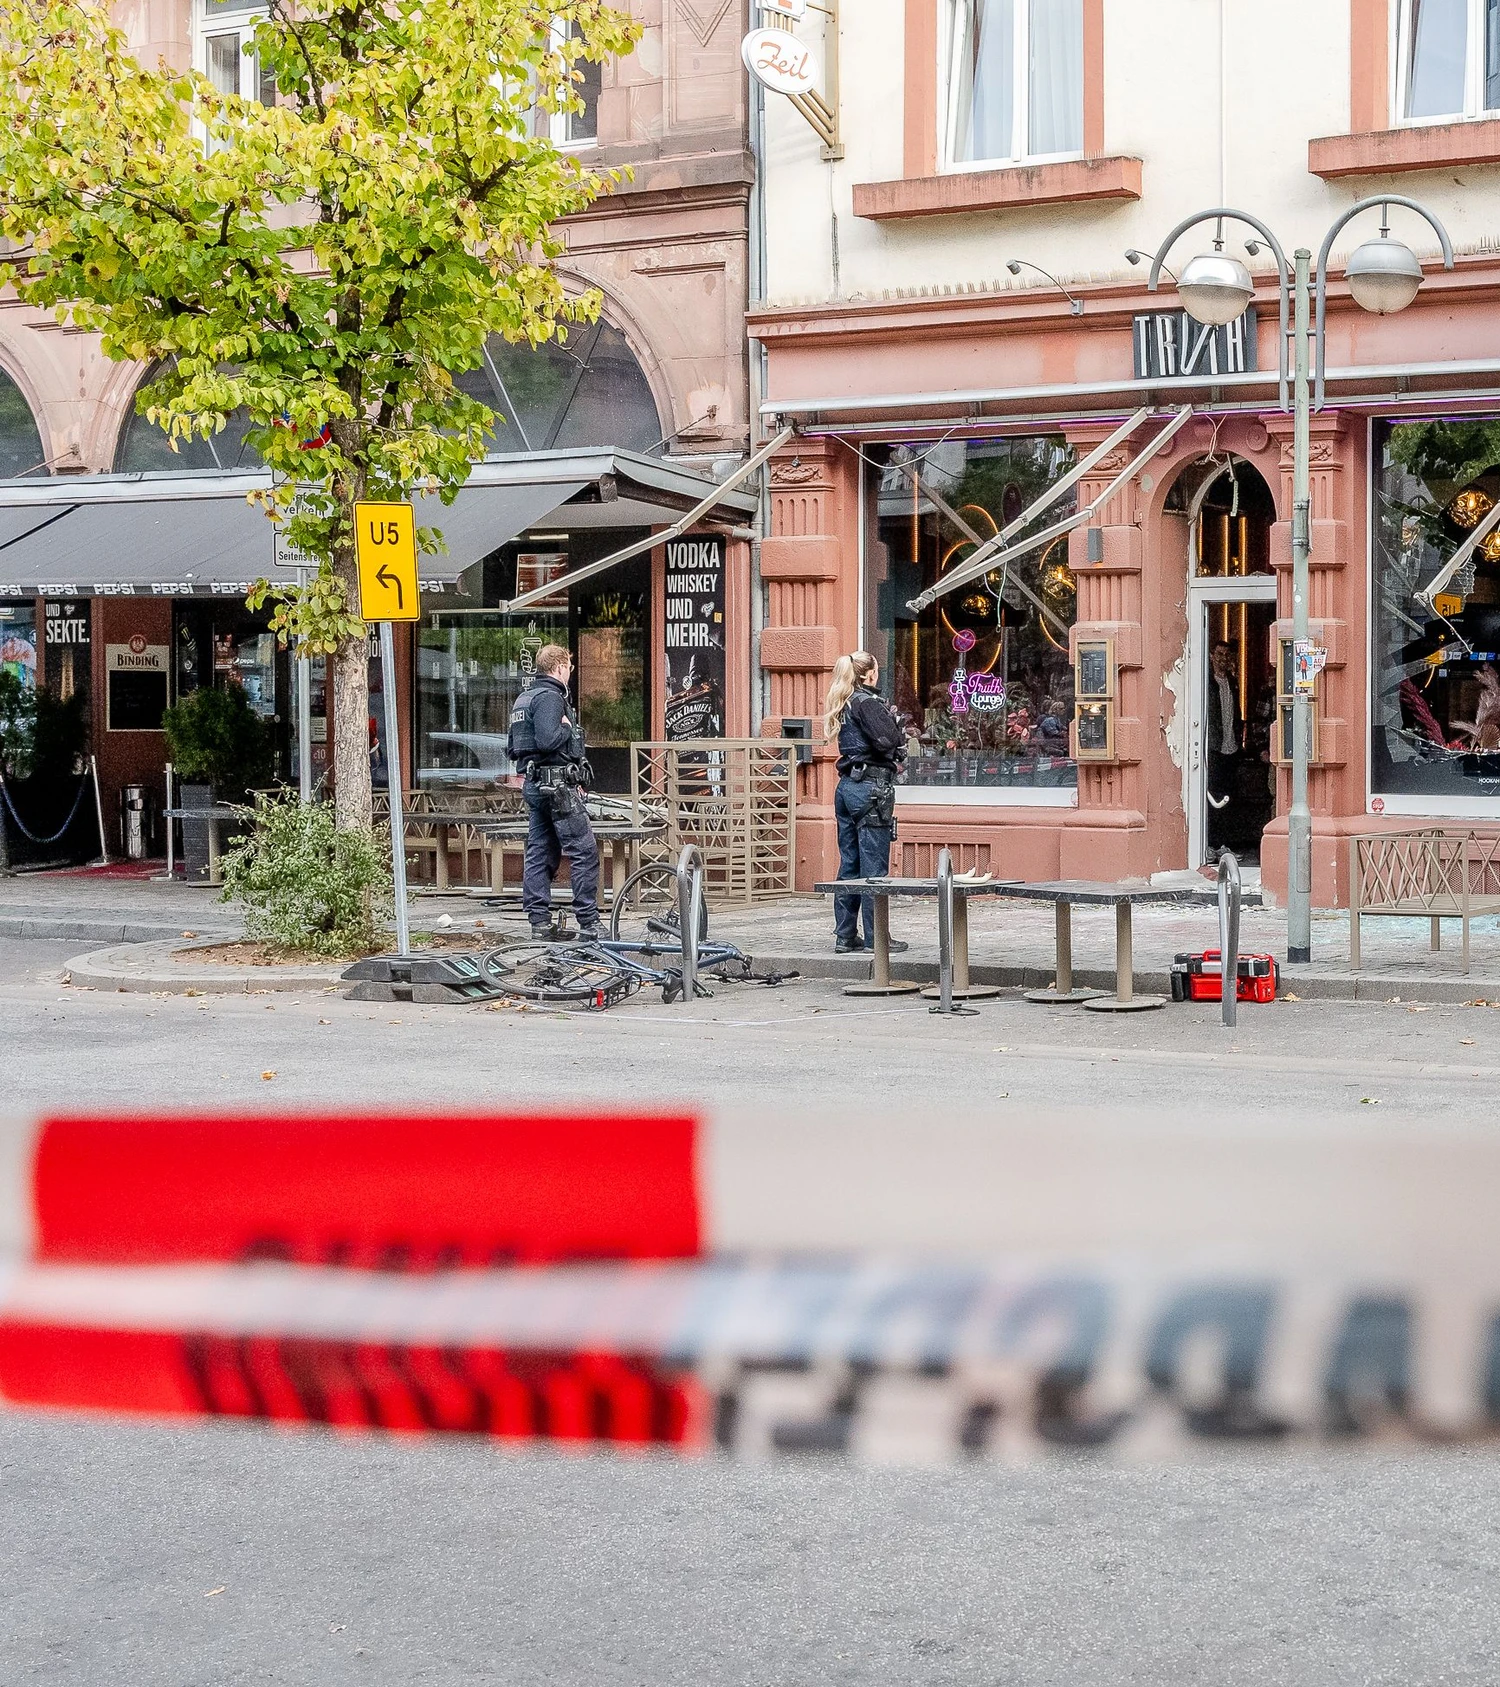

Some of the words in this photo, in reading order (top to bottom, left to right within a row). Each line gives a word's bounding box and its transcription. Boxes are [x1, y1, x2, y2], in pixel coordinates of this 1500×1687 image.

[757, 41, 808, 80] Zeil
[370, 521, 399, 546] U5
[667, 542, 720, 569] VODKA
[0, 584, 23, 596] PSI
[37, 583, 79, 596] PEPSI
[93, 583, 136, 595] PEPSI
[151, 582, 194, 594] PEPSI
[667, 574, 718, 593] WHISKEY
[46, 603, 60, 617] UND
[667, 598, 693, 620] UND
[46, 619, 90, 643] SEKTE.
[667, 623, 713, 647] MEHR.
[117, 653, 159, 667] BINDING
[968, 673, 1002, 694] Truth
[973, 692, 1001, 705] Lounge
[665, 710, 683, 729] JACK
